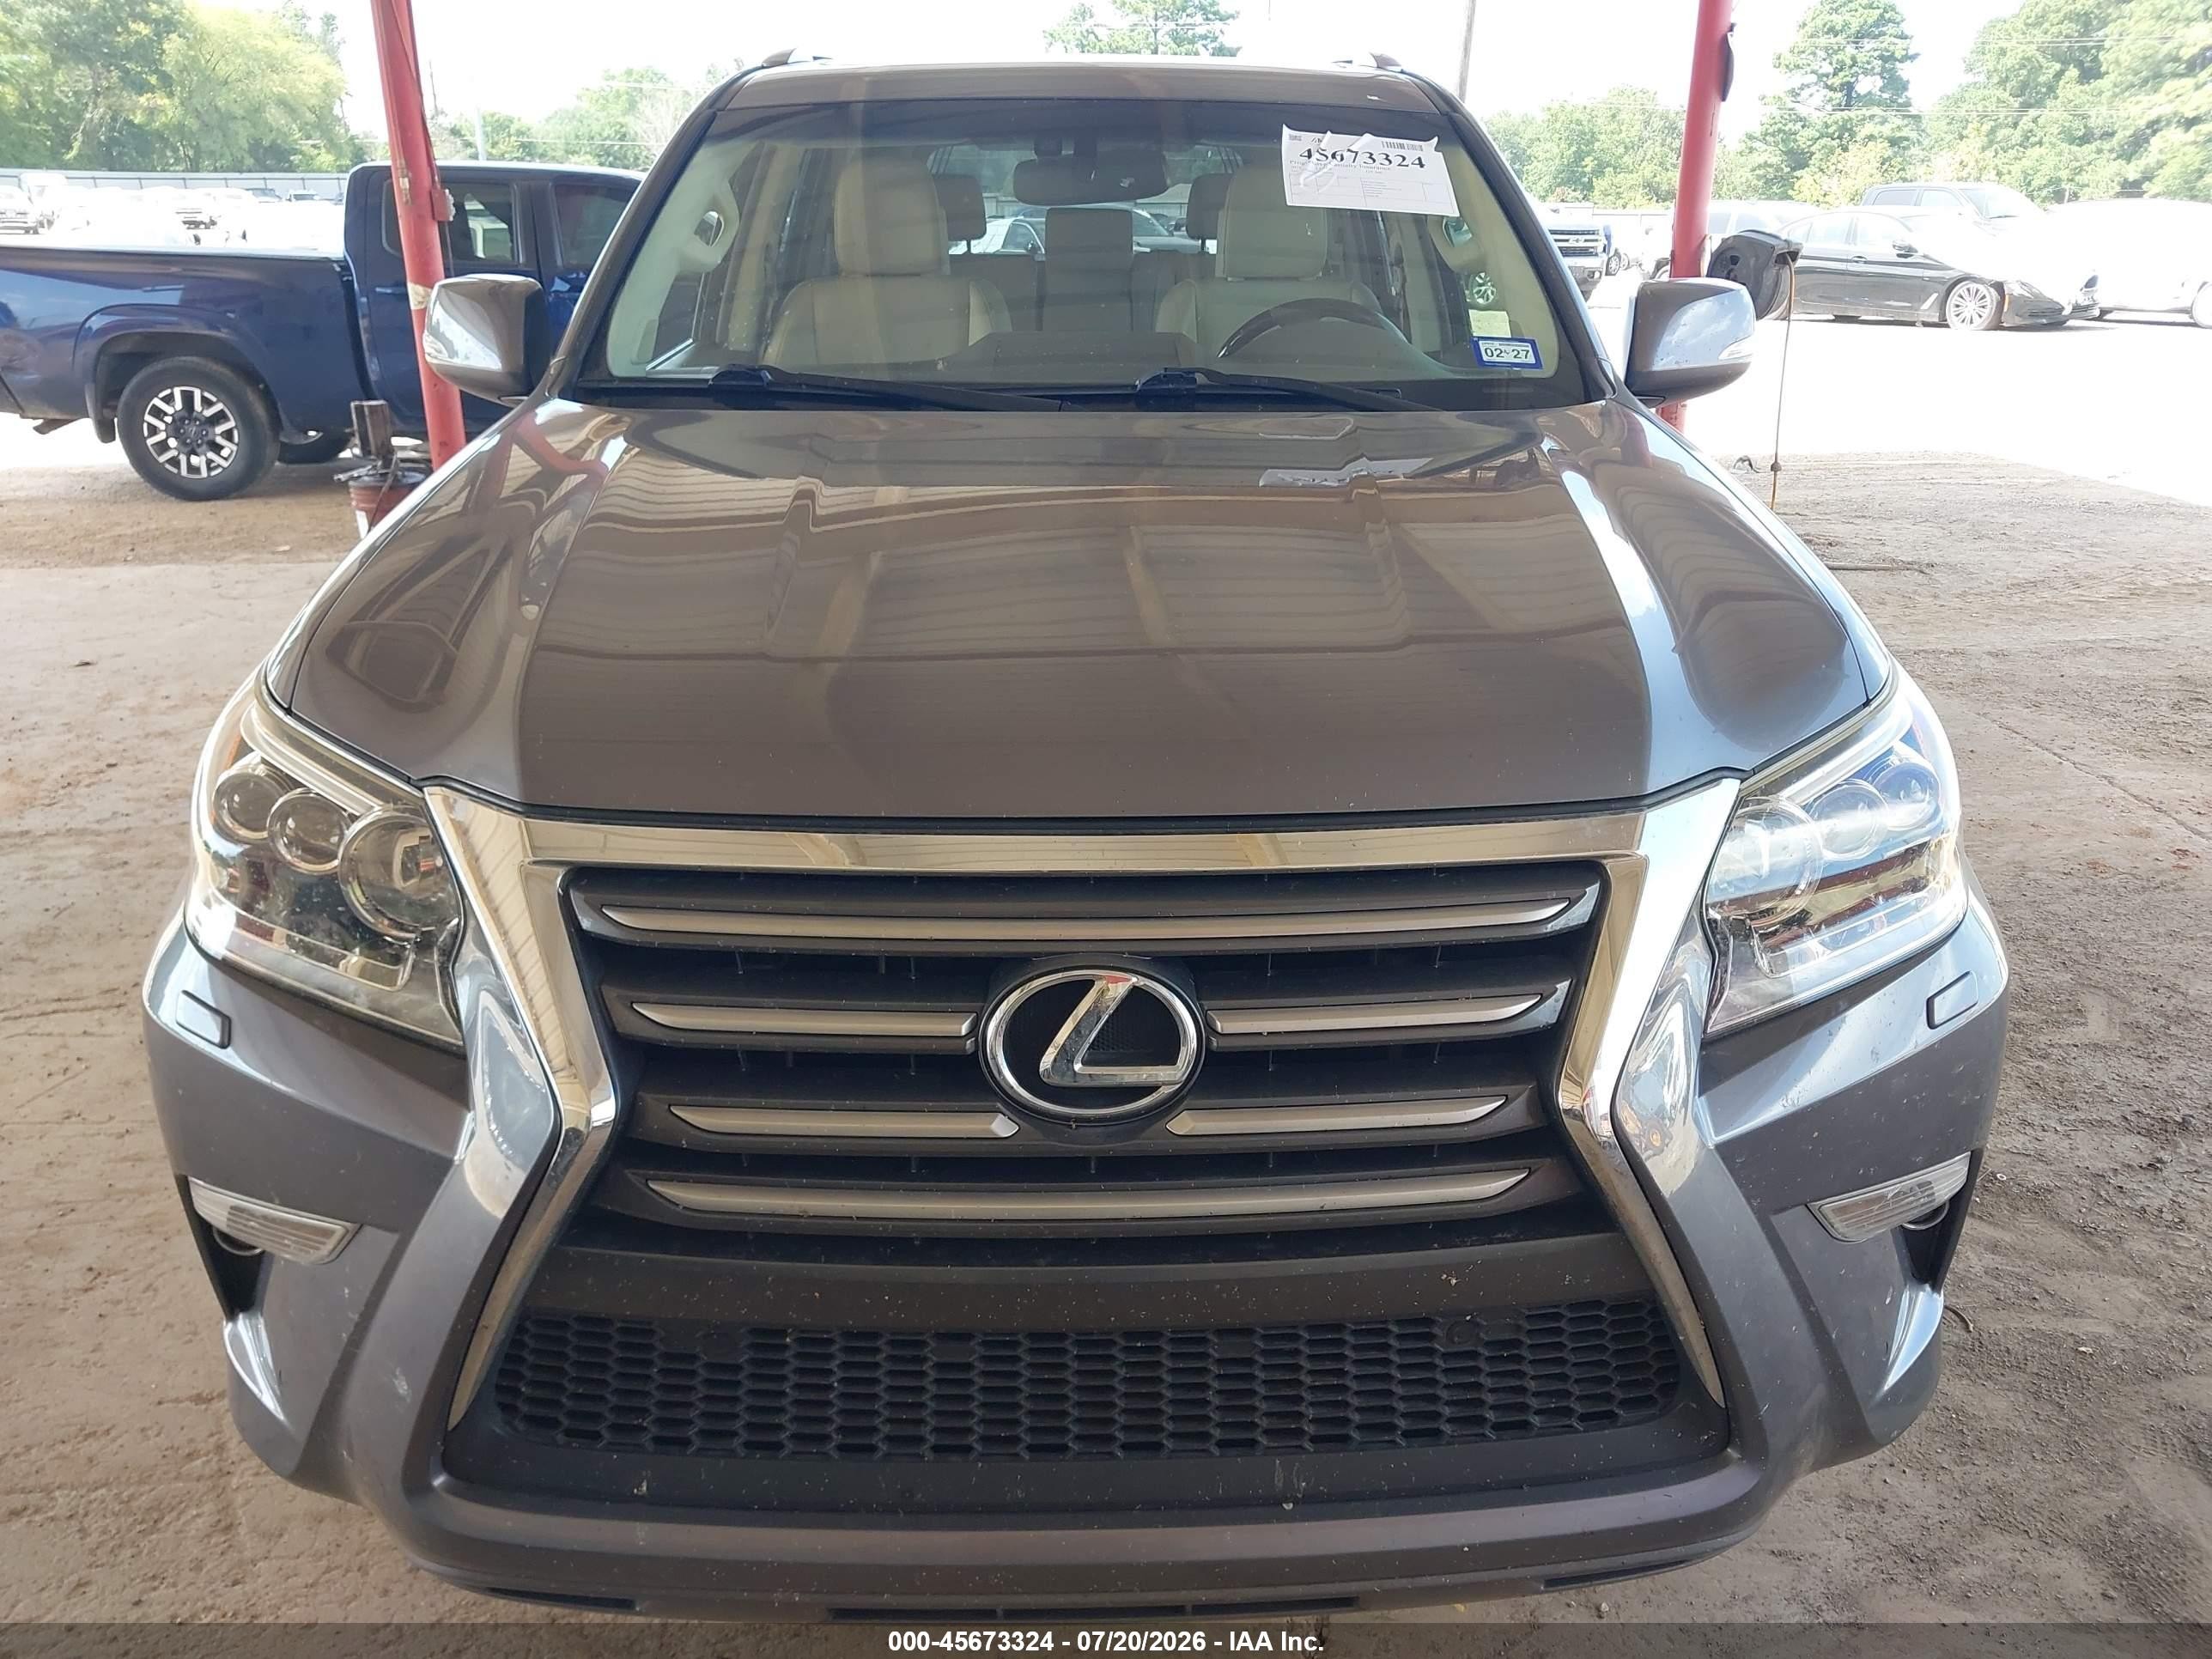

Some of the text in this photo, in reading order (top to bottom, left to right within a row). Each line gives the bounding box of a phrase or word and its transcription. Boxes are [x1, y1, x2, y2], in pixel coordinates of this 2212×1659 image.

[1299, 148, 1425, 168] 45673324
[1484, 347, 1530, 360] 02 27
